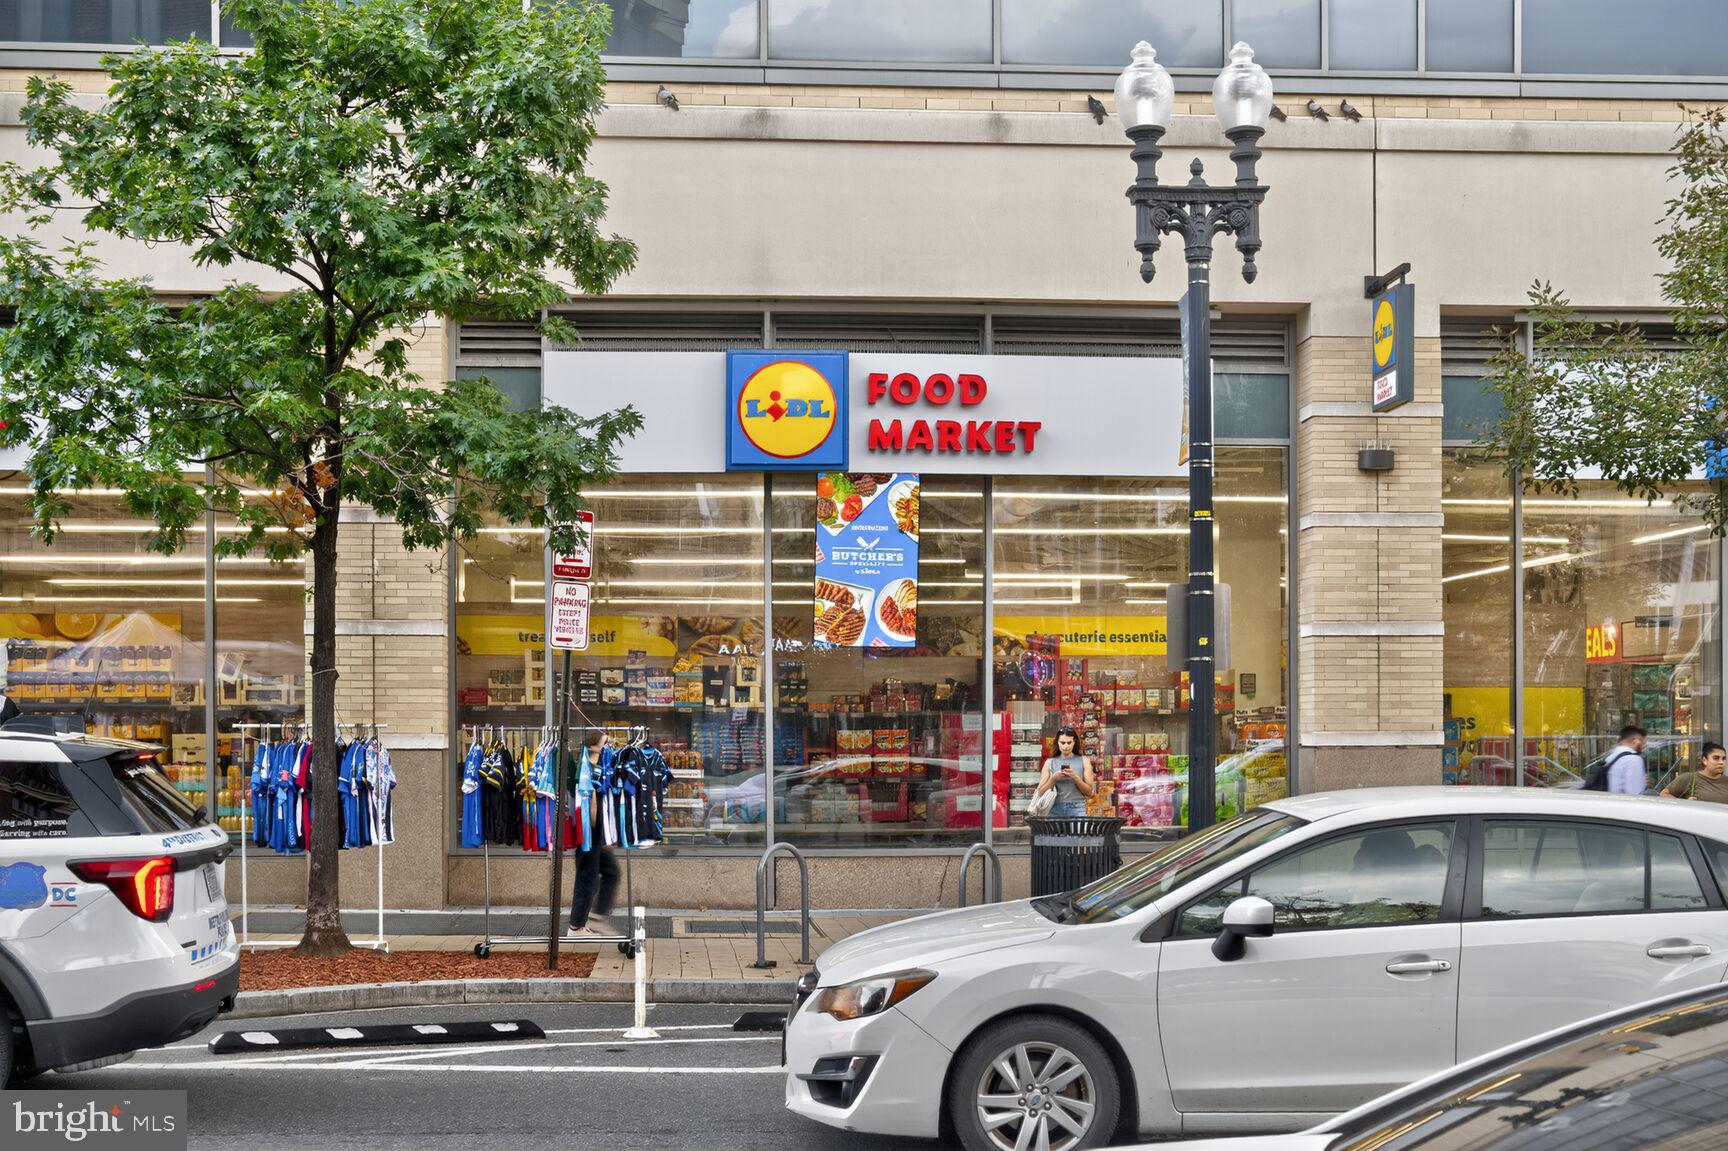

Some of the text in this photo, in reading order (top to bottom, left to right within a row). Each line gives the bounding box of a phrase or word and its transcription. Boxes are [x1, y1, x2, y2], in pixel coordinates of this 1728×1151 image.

[868, 372, 987, 406] FOOD
[868, 419, 1042, 452] MARKET
[831, 551, 904, 562] BUTCHER'S
[565, 586, 577, 596] NO
[554, 597, 587, 608] PARKING
[518, 631, 546, 643] trea
[1109, 630, 1167, 643] essentia
[1586, 626, 1616, 658] EALS
[52, 887, 77, 901] DC
